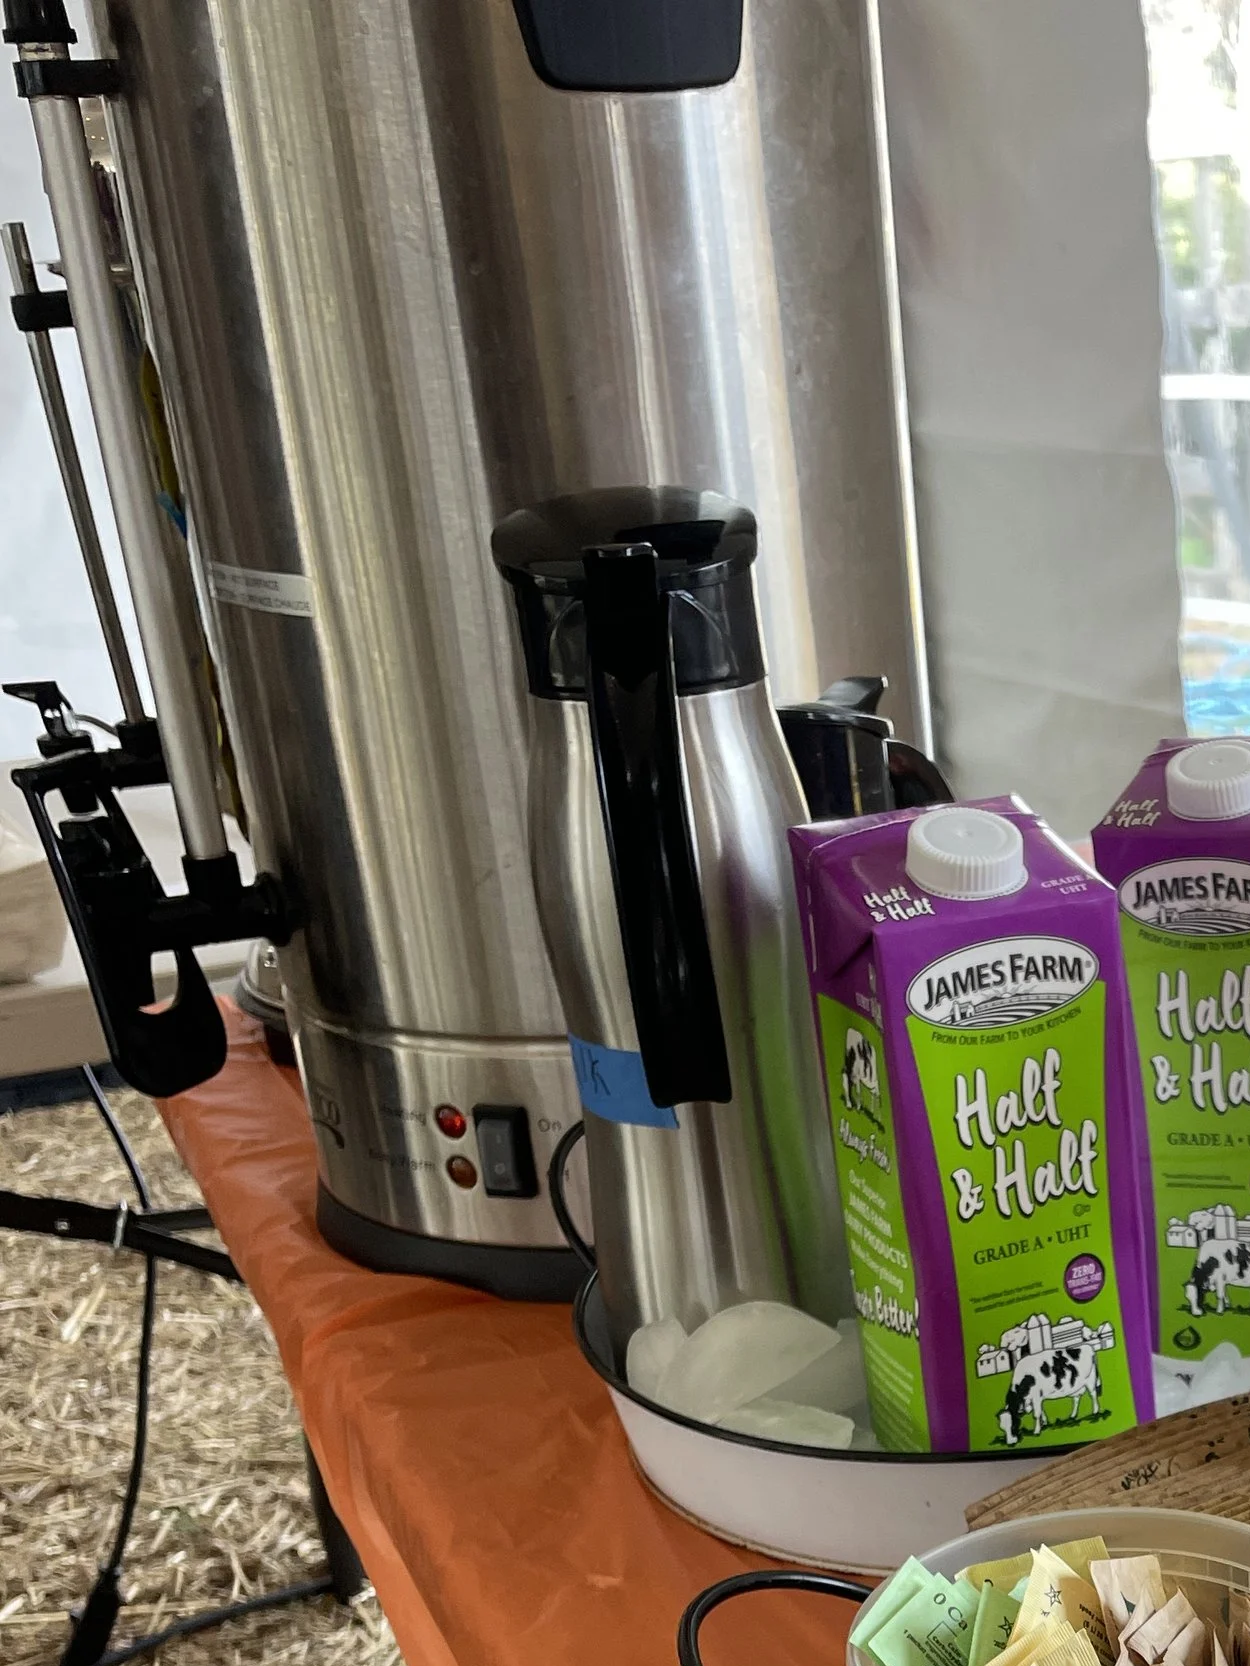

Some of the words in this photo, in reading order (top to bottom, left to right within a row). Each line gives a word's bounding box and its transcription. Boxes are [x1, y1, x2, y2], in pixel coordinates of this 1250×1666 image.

[1115, 811, 1162, 828] Half
[863, 886, 912, 908] Half
[870, 910, 887, 923] &
[886, 897, 936, 921] Half
[1133, 874, 1210, 910] JAMES
[924, 959, 1004, 1011] JAMES
[1009, 952, 1084, 984] FARM
[954, 1047, 1063, 1149] Half
[1150, 1055, 1182, 1103] &
[1167, 1132, 1223, 1147] GRADE
[1224, 1133, 1235, 1147] A
[952, 1168, 985, 1222] &
[993, 1119, 1099, 1219] Half
[973, 1239, 1029, 1266] GRADE
[1029, 1236, 1044, 1250] A
[1055, 1223, 1092, 1246] UHT
